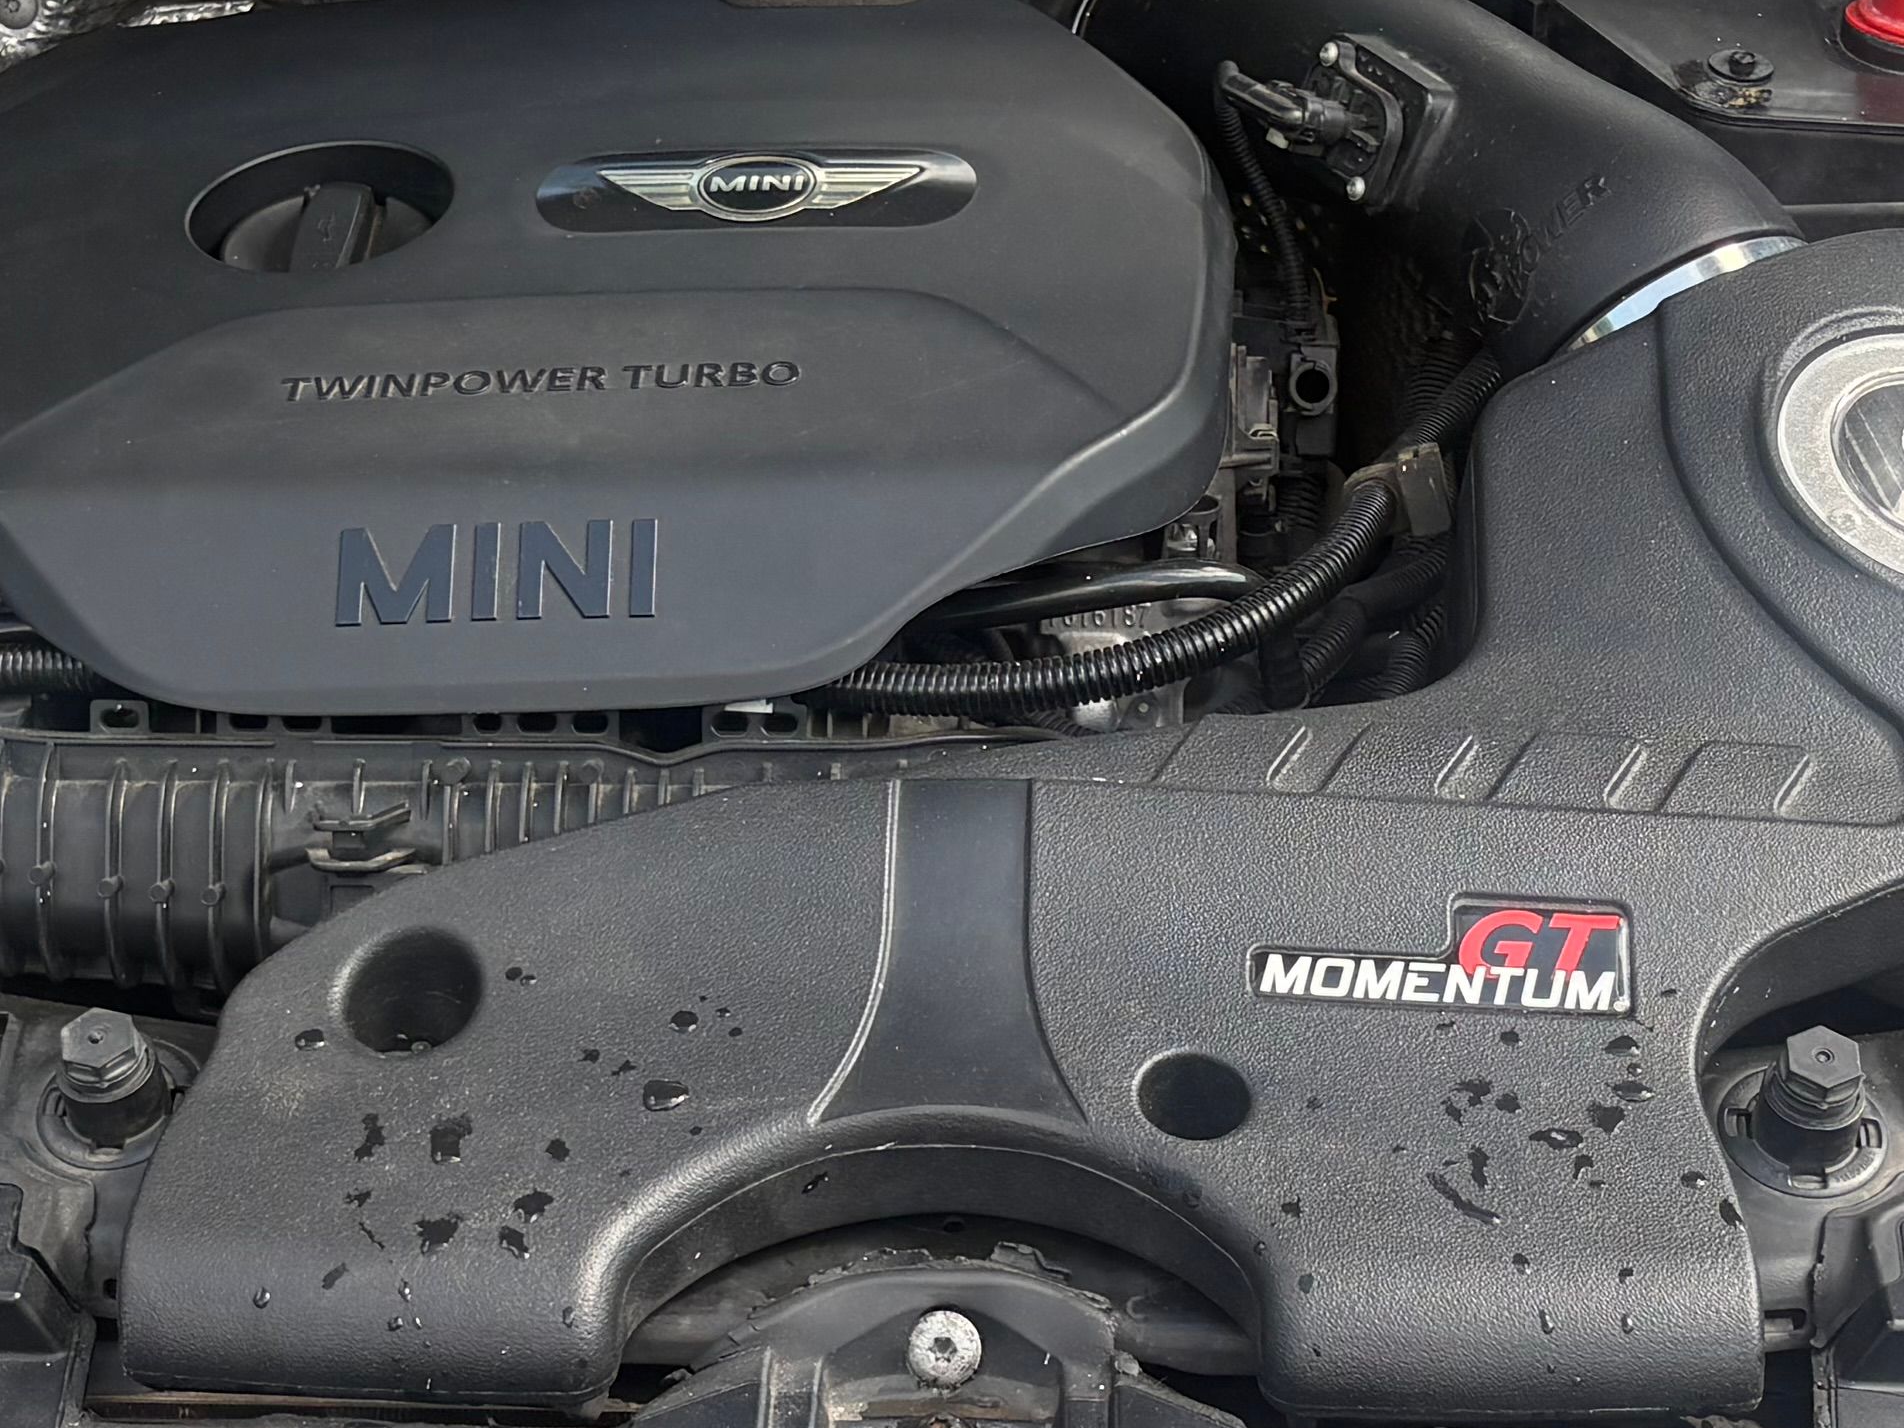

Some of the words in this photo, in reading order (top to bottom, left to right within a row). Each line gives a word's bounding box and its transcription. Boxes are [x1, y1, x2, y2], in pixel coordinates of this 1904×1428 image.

[709, 174, 805, 192] MINI
[282, 365, 608, 402] TWINPOWER
[623, 360, 802, 390] TURBO
[334, 518, 658, 627] MINI
[1458, 909, 1624, 980] GT
[1259, 953, 1617, 1012] MOMENTUM
